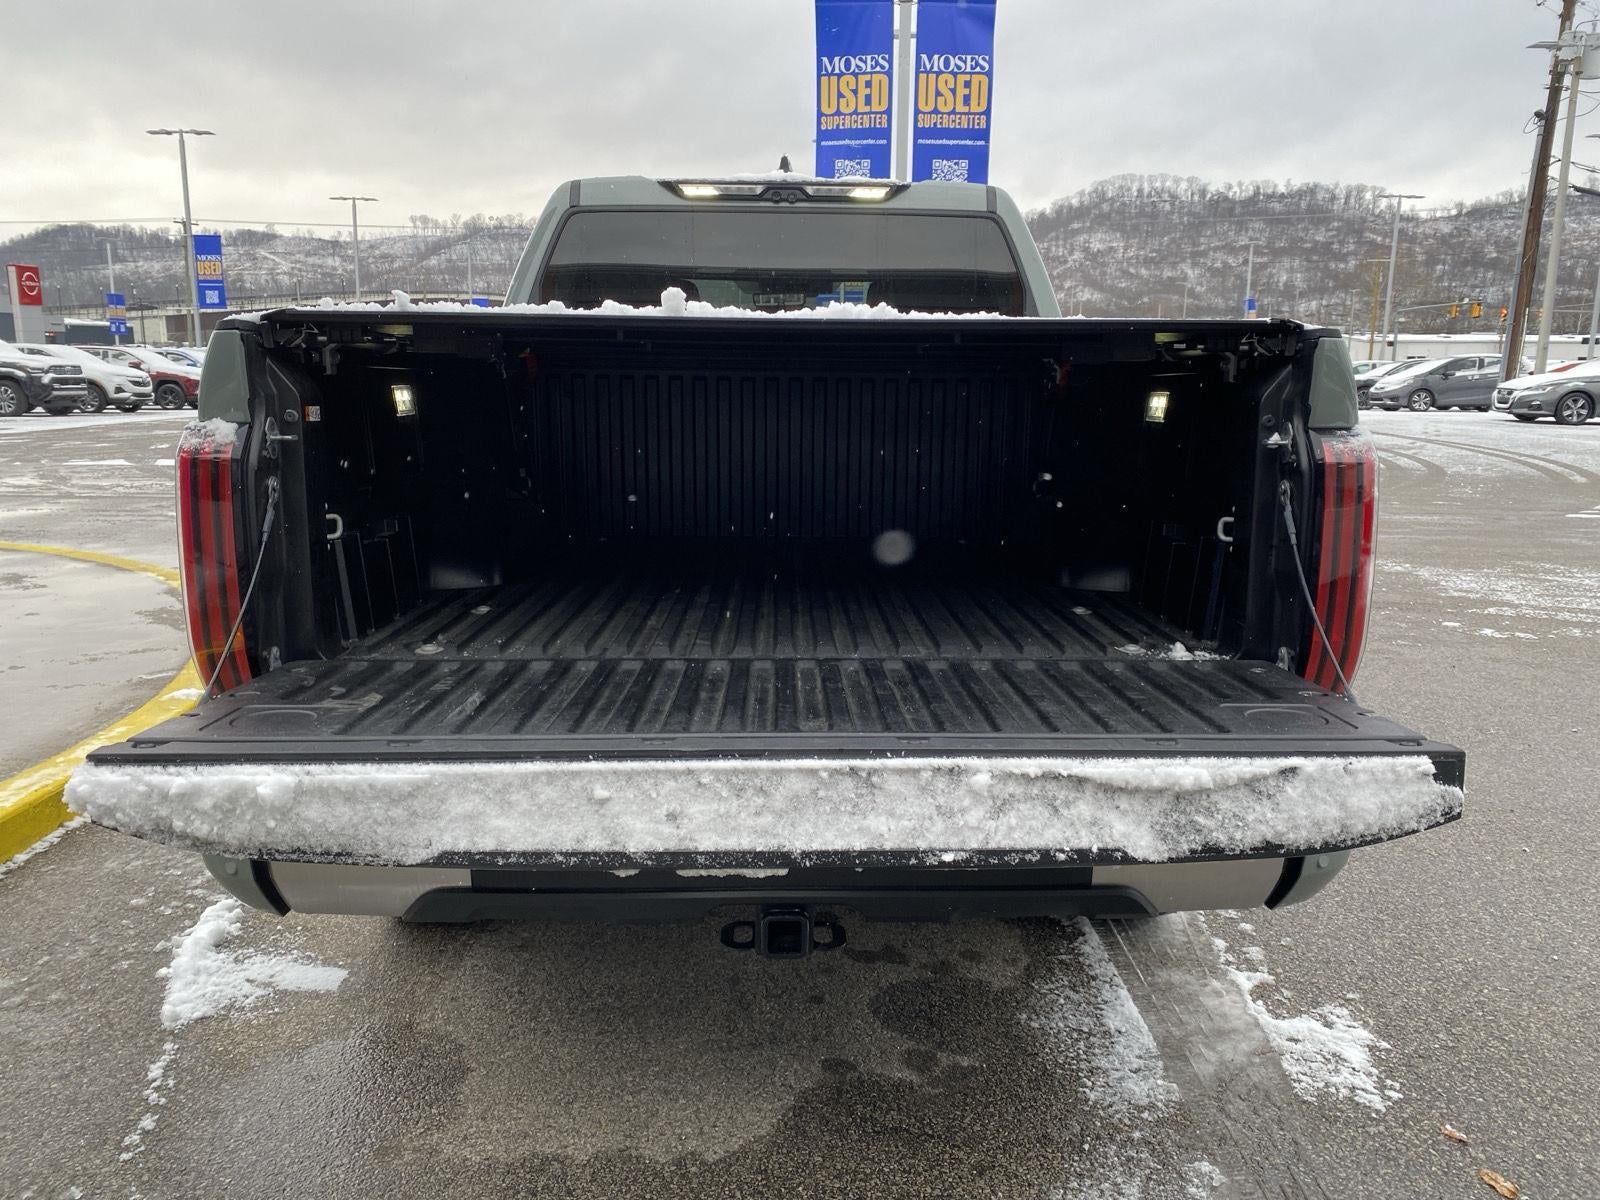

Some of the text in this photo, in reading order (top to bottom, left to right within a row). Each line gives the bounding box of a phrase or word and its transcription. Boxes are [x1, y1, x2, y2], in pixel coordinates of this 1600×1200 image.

[821, 54, 889, 74] MOSES
[919, 54, 989, 73] MOSES
[820, 74, 889, 114] USED
[917, 73, 988, 113] USED
[820, 115, 887, 130] SUPERCENTER
[918, 114, 986, 129] SUPERCENTER
[820, 138, 887, 147] mosesusedsupercenter.com
[917, 138, 986, 146] mosesusedsupercenter.com
[197, 261, 222, 275] USED
